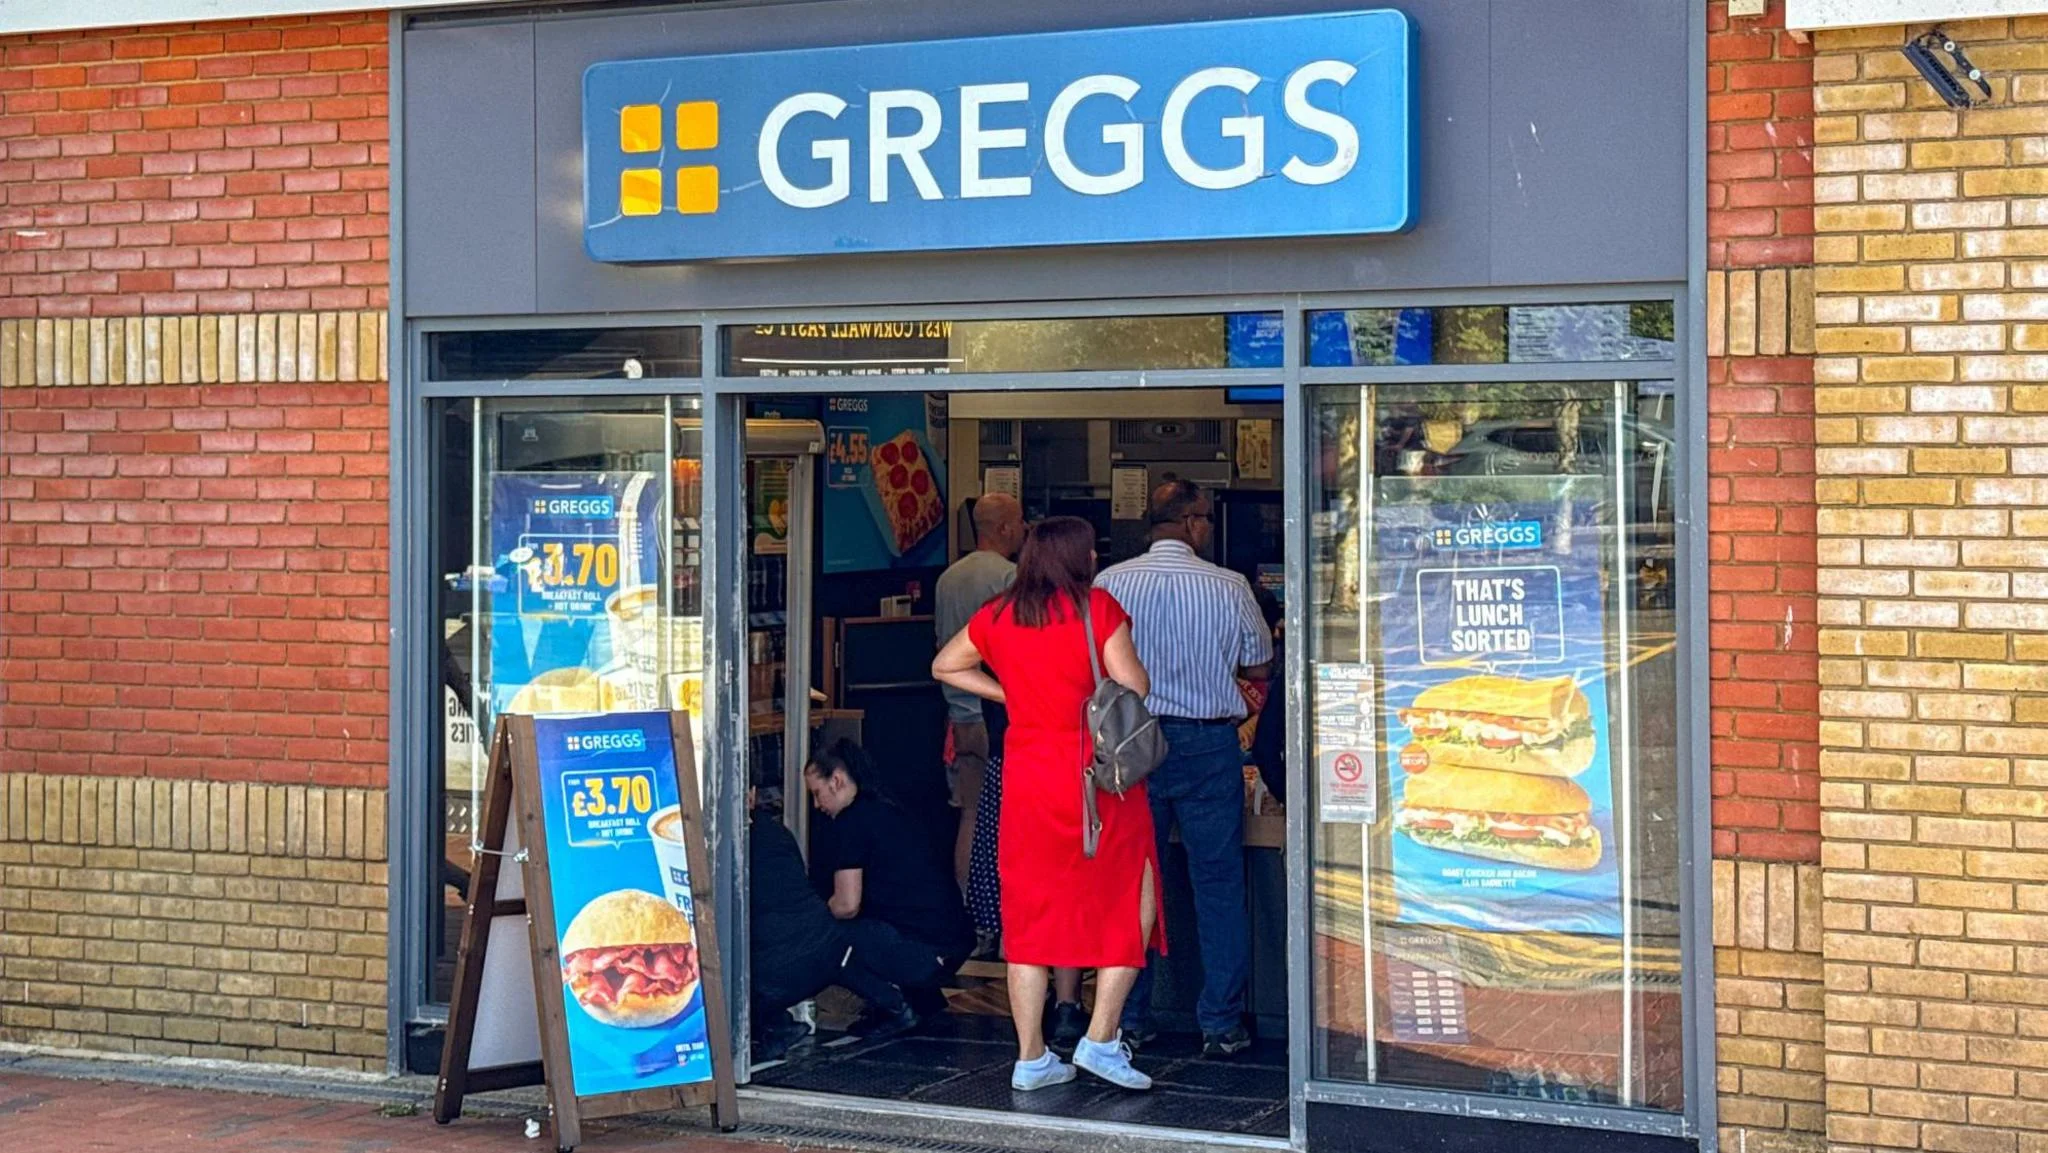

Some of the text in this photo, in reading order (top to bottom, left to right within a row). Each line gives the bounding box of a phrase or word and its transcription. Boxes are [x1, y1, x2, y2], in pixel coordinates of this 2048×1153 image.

[758, 59, 1362, 209] GREGGS
[837, 399, 869, 412] GREGGS
[830, 432, 868, 464] £4.55
[549, 500, 609, 514] GREGGS
[1456, 527, 1535, 544] GREGGS
[1452, 578, 1525, 601] THAT'S
[1456, 605, 1524, 627] LUNCH
[1451, 630, 1531, 652] SORTED
[582, 734, 641, 750] GREGGS
[572, 775, 652, 817] £3.70
